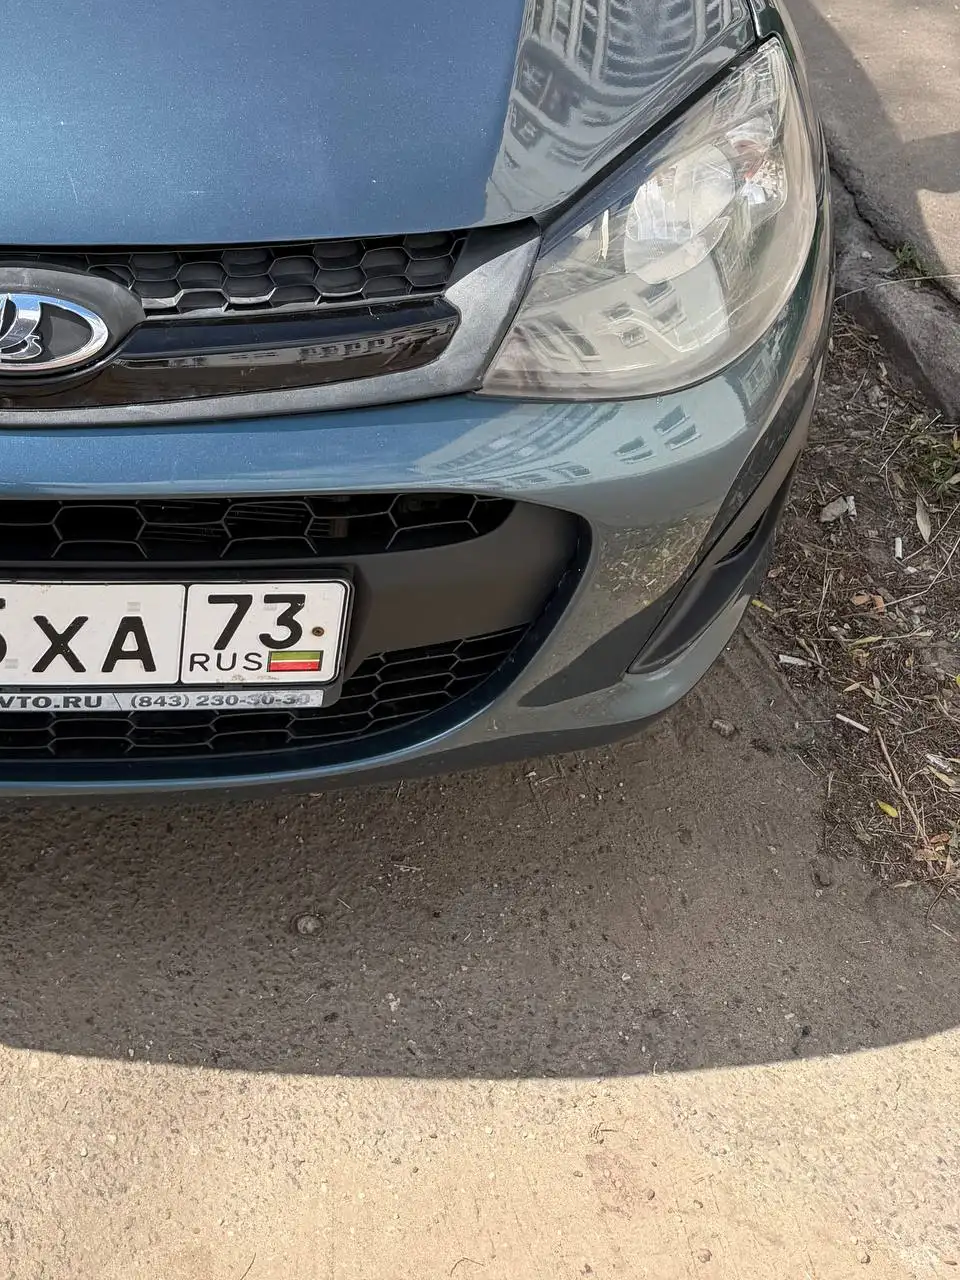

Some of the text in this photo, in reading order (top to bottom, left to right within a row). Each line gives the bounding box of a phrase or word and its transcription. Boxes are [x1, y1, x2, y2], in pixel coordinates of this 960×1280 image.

[207, 594, 306, 650] 73
[189, 652, 263, 672] RUS
[131, 694, 189, 708] (843)
